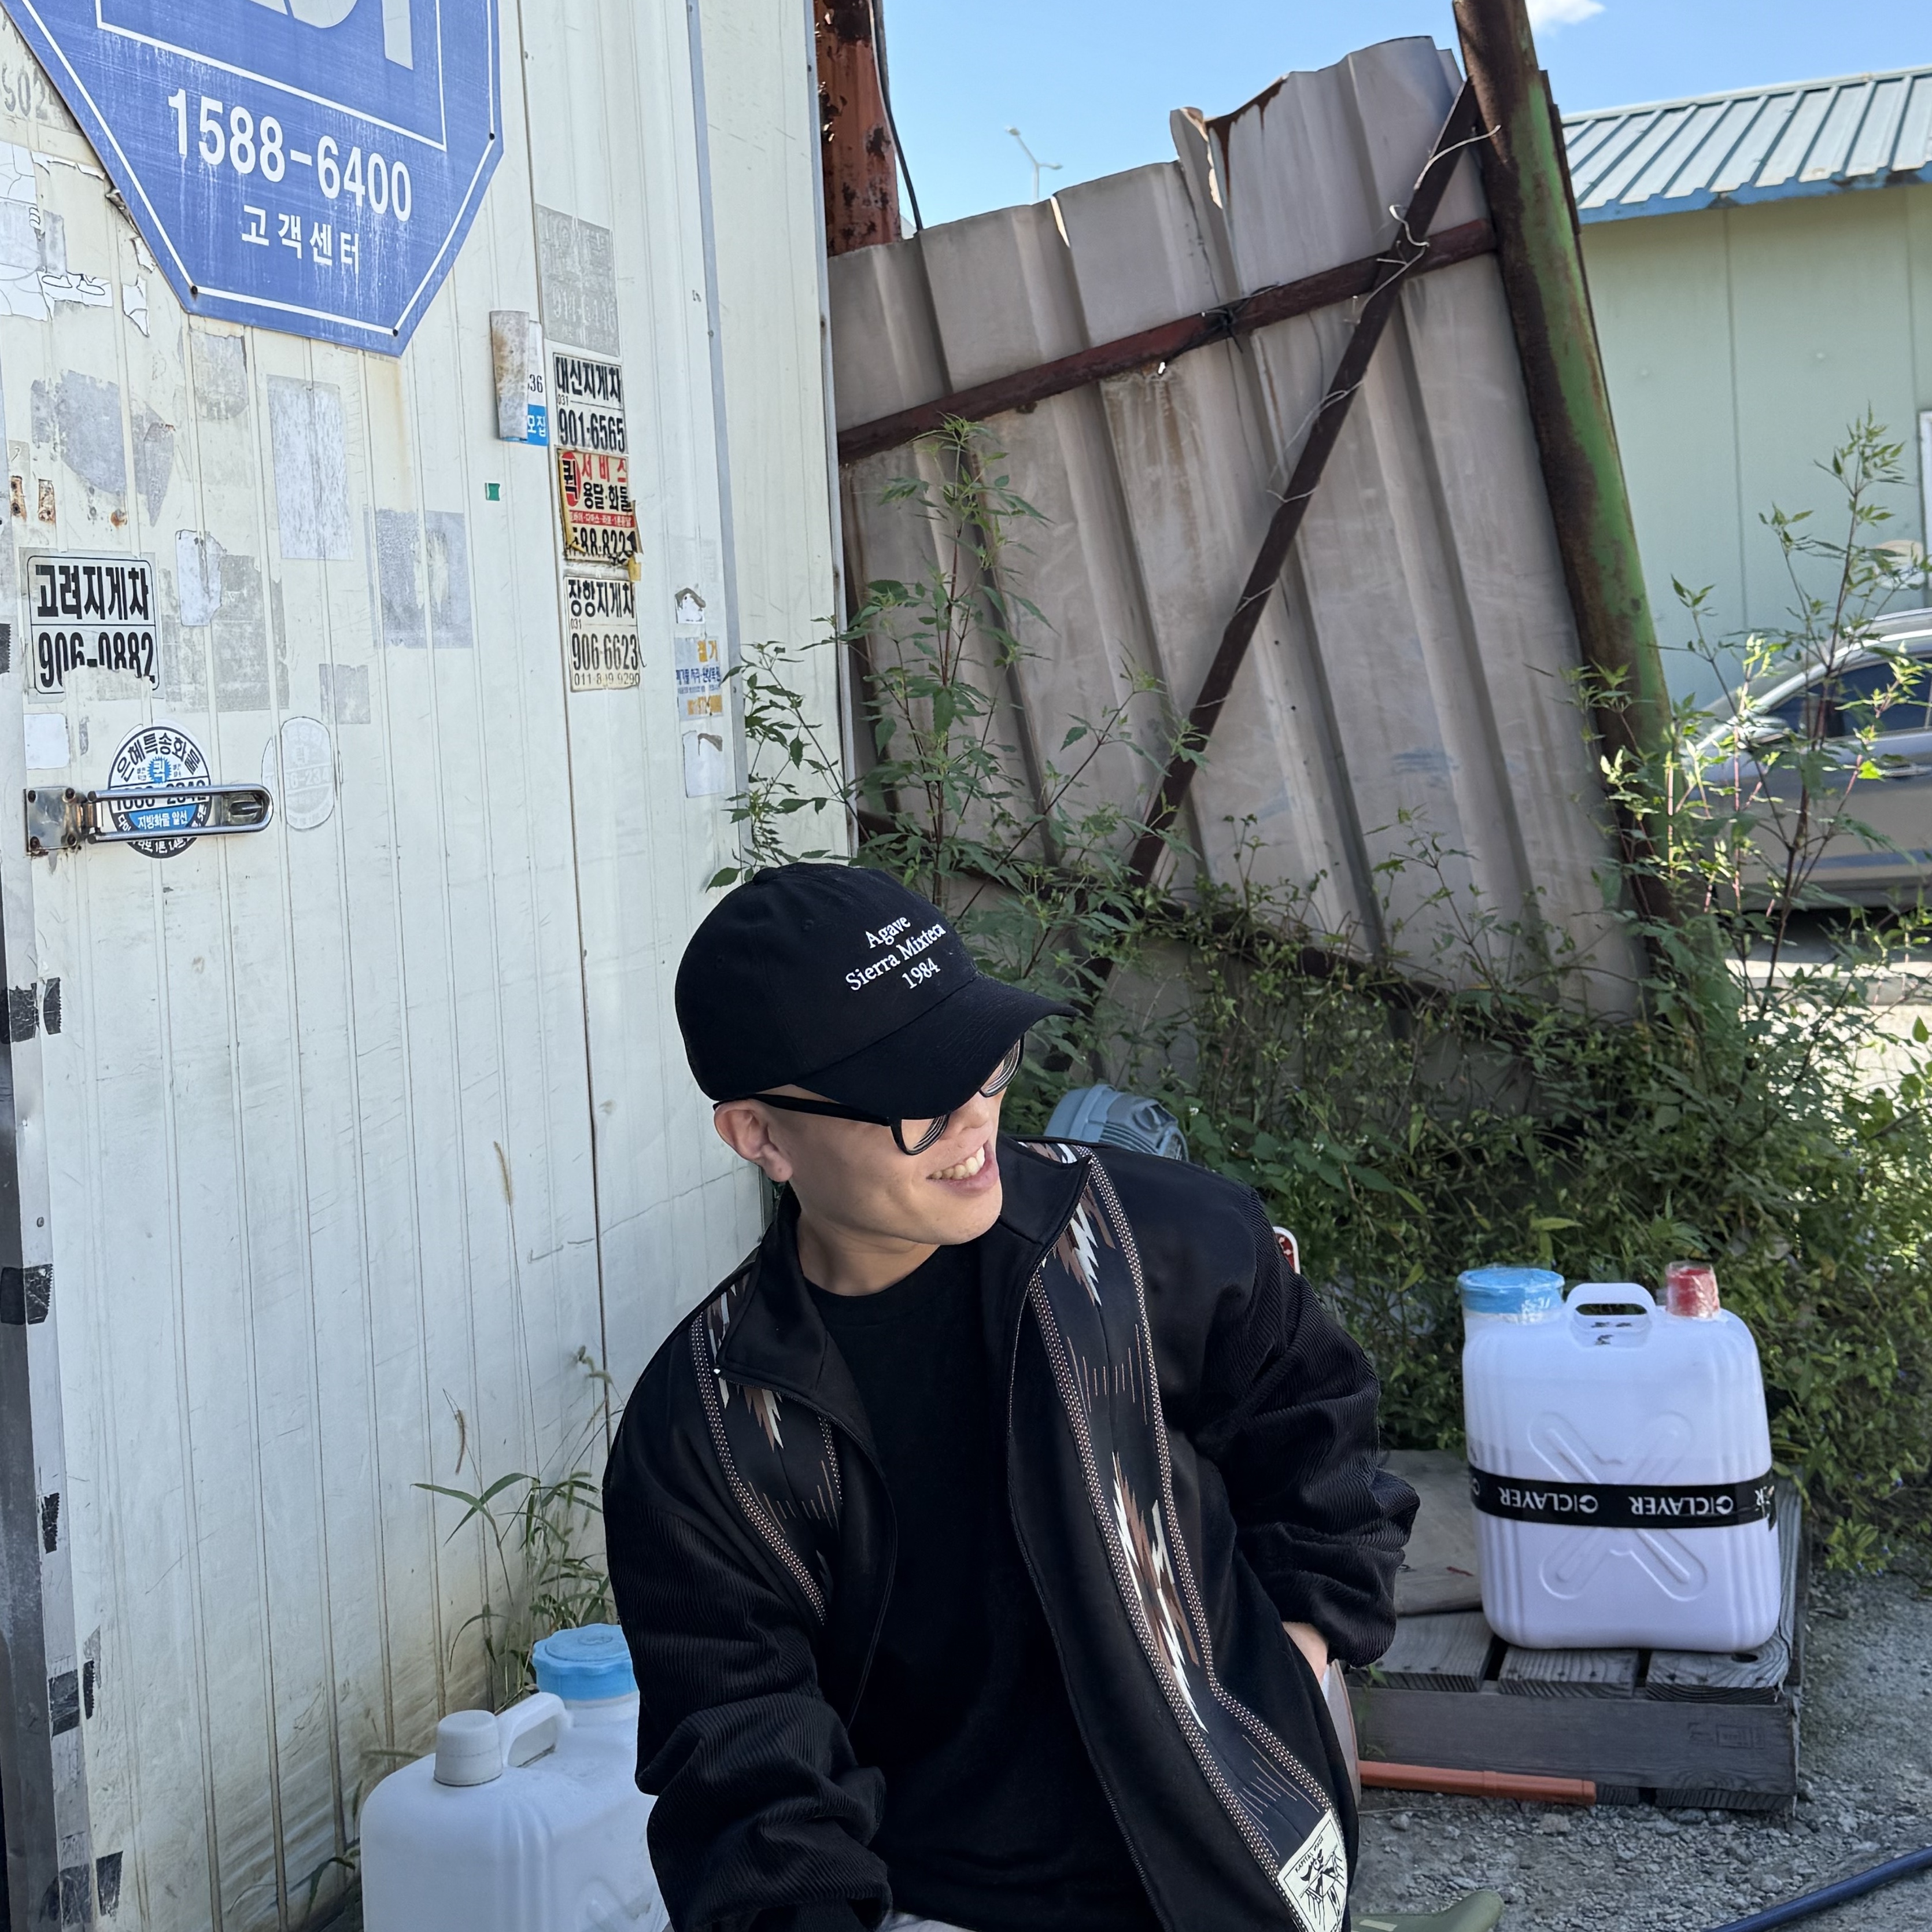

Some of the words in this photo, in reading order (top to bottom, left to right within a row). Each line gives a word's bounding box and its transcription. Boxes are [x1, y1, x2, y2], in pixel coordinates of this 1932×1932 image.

[168, 88, 412, 222] 1588-6400
[241, 204, 359, 276] 고객센터
[527, 374, 543, 393] 36
[555, 356, 622, 402] 대신지게차
[35, 564, 149, 620] 고려지게차
[568, 579, 635, 619] 장항지게차
[117, 732, 201, 783] 은혜특송화물
[865, 917, 911, 948] Agave
[845, 954, 901, 991] Sierra
[902, 957, 941, 989] 1984
